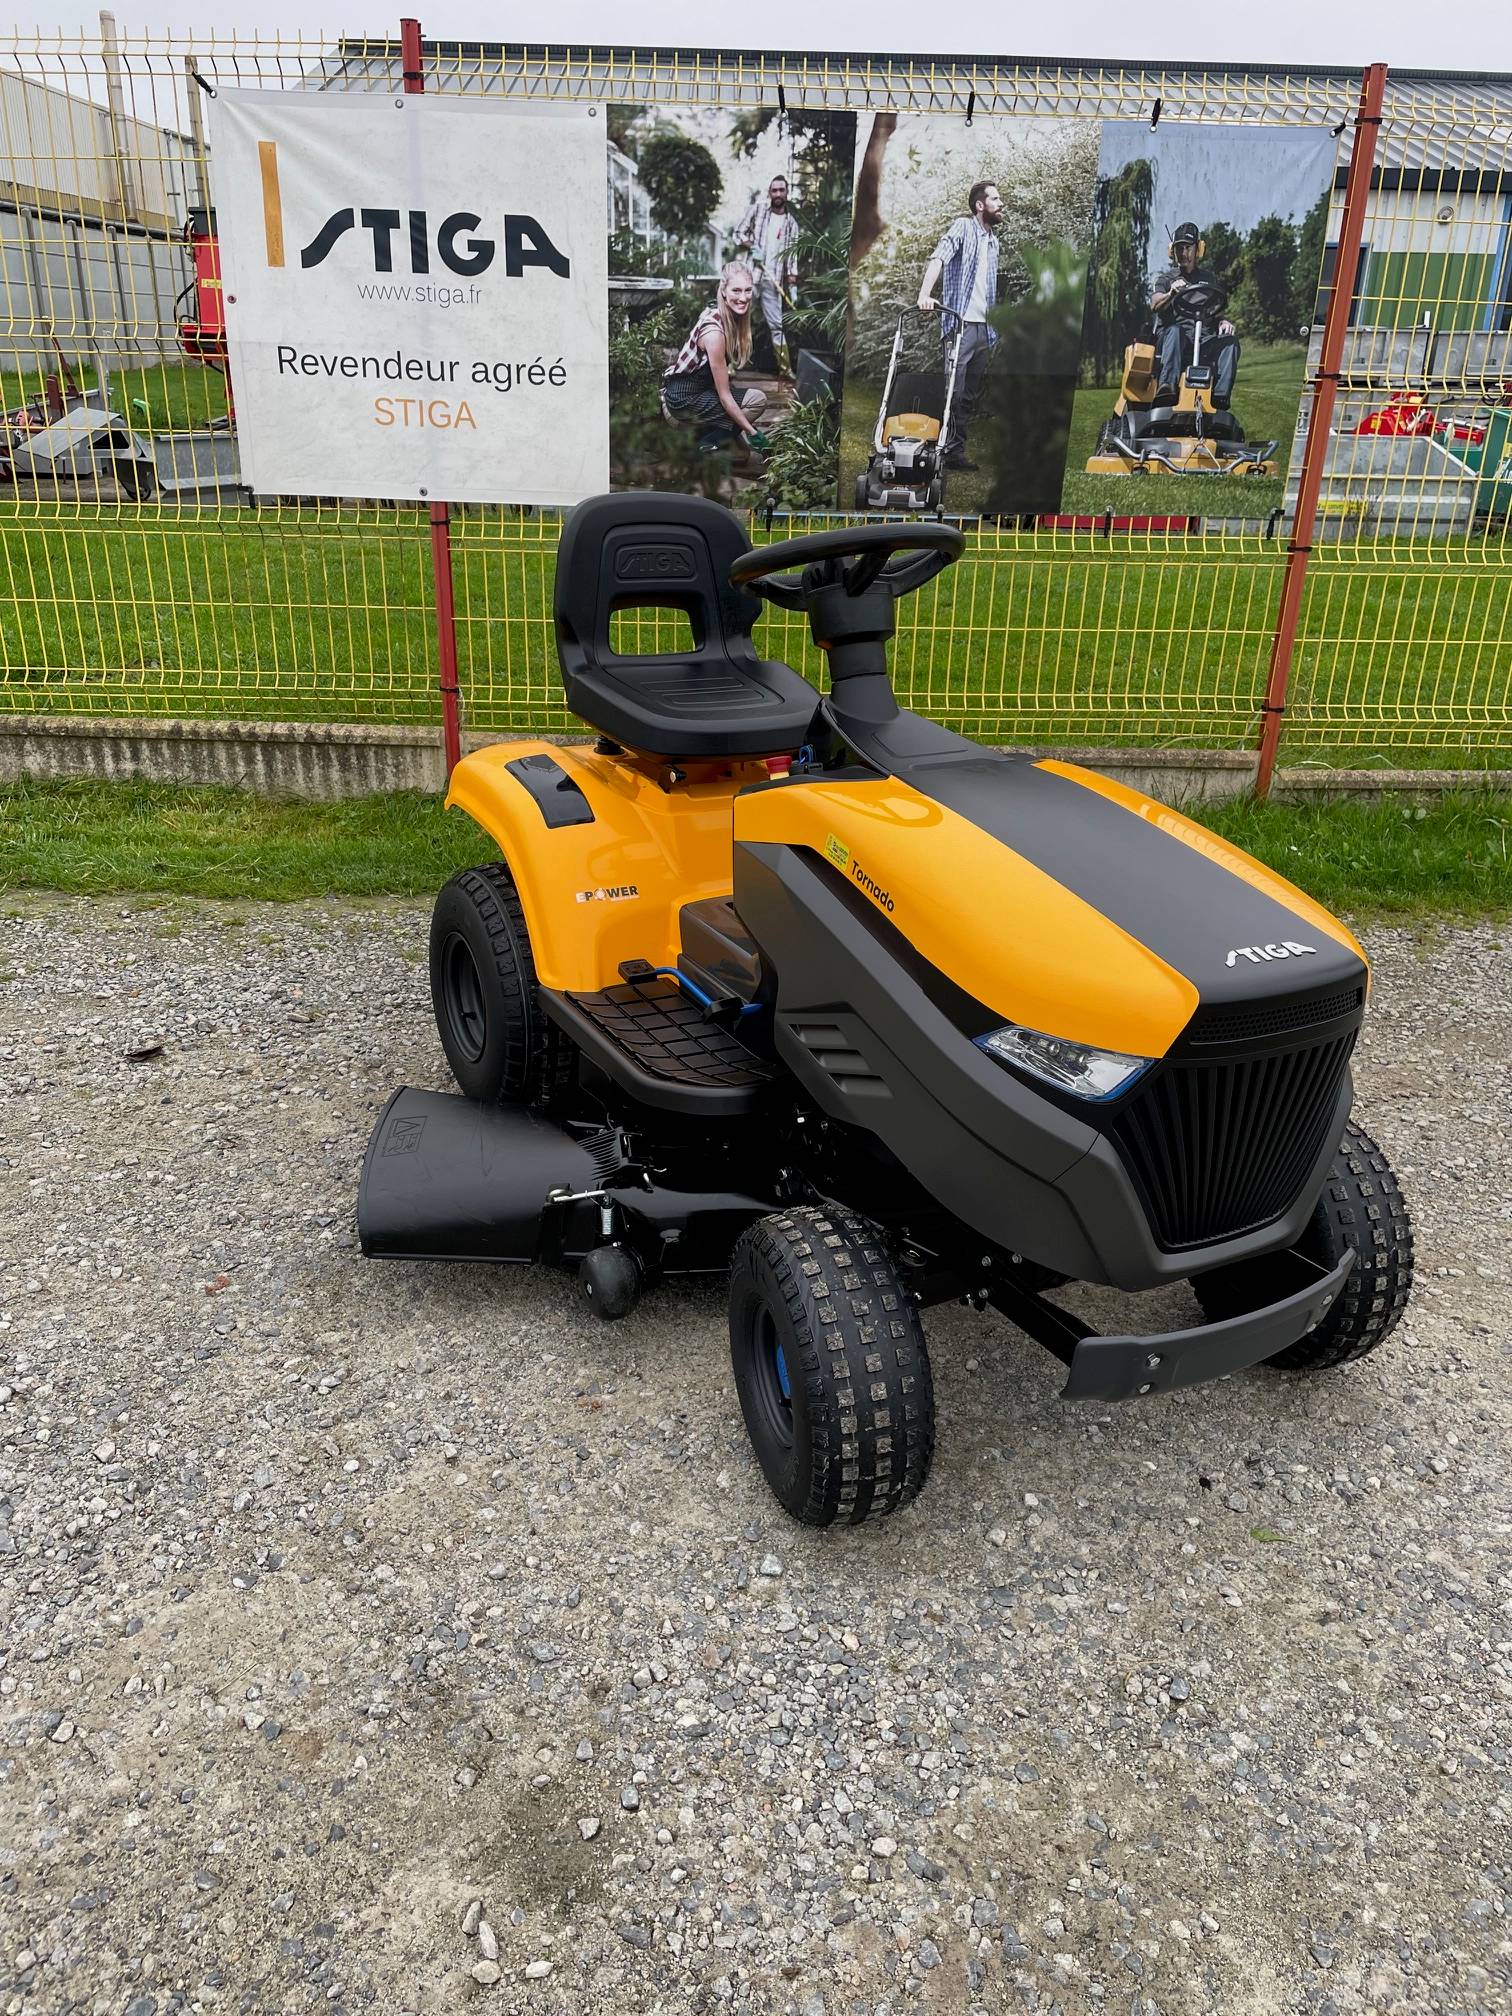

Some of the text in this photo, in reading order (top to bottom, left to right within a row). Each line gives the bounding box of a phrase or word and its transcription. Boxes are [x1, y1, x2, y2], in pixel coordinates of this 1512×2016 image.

[301, 208, 570, 279] STIGA
[357, 282, 483, 308] www.stiga.fr
[277, 345, 568, 392] Revendeur agréé
[374, 397, 477, 429] STIGA
[620, 552, 690, 573] STIGA
[851, 860, 895, 912] Tornado
[1224, 941, 1318, 968] STIGA
